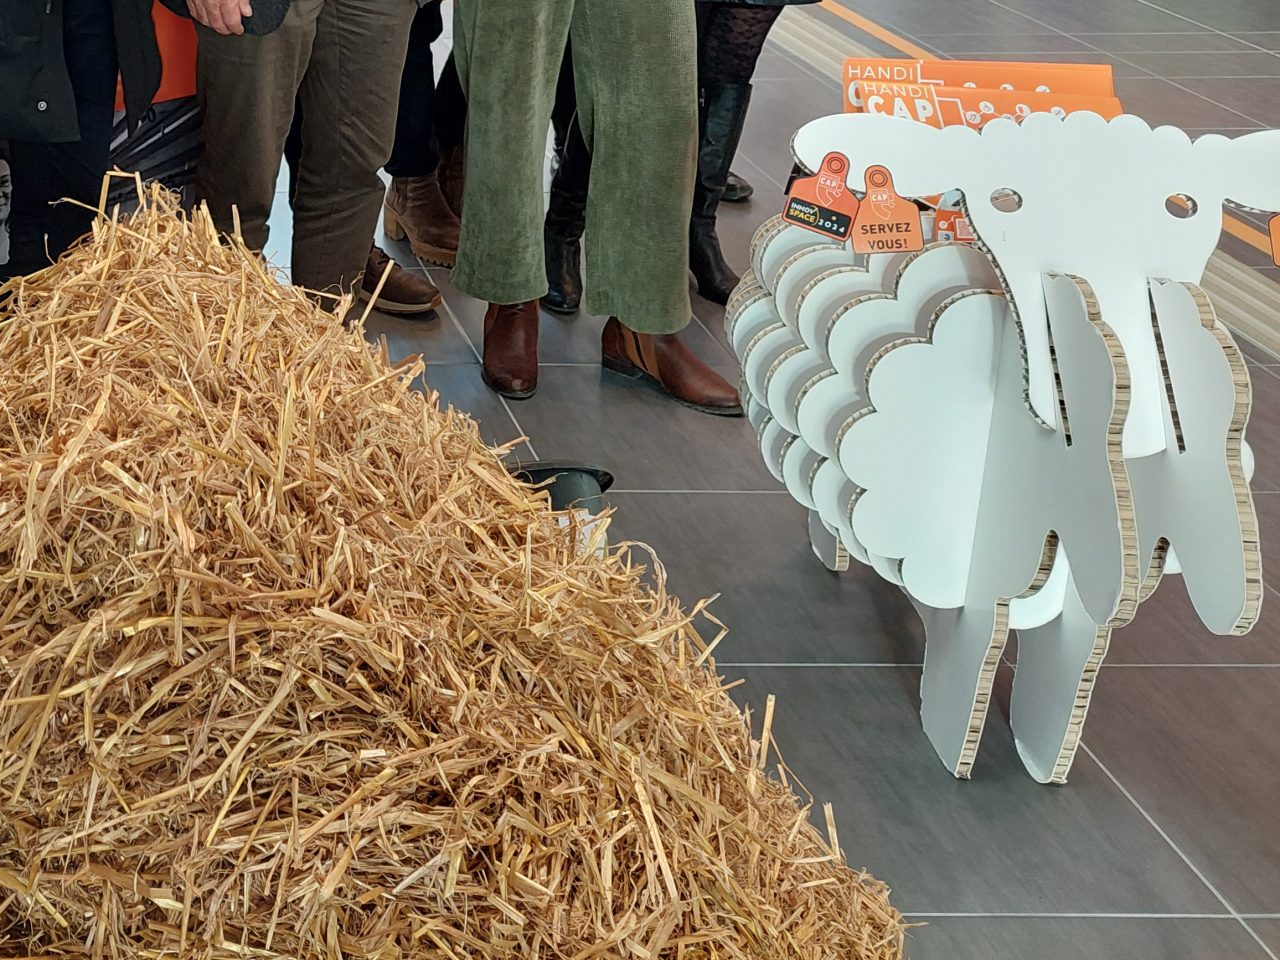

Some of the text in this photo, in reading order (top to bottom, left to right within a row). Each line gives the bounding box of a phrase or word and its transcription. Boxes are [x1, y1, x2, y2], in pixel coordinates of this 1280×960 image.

[848, 64, 914, 82] HANDI
[864, 82, 929, 99] HANDI
[867, 95, 934, 124] CAP
[820, 177, 837, 188] CAP
[871, 194, 888, 202] CAP
[788, 208, 817, 223] SPACE
[791, 202, 815, 215] INNOV
[817, 217, 846, 234] 2024
[861, 222, 912, 235] SERVEZ
